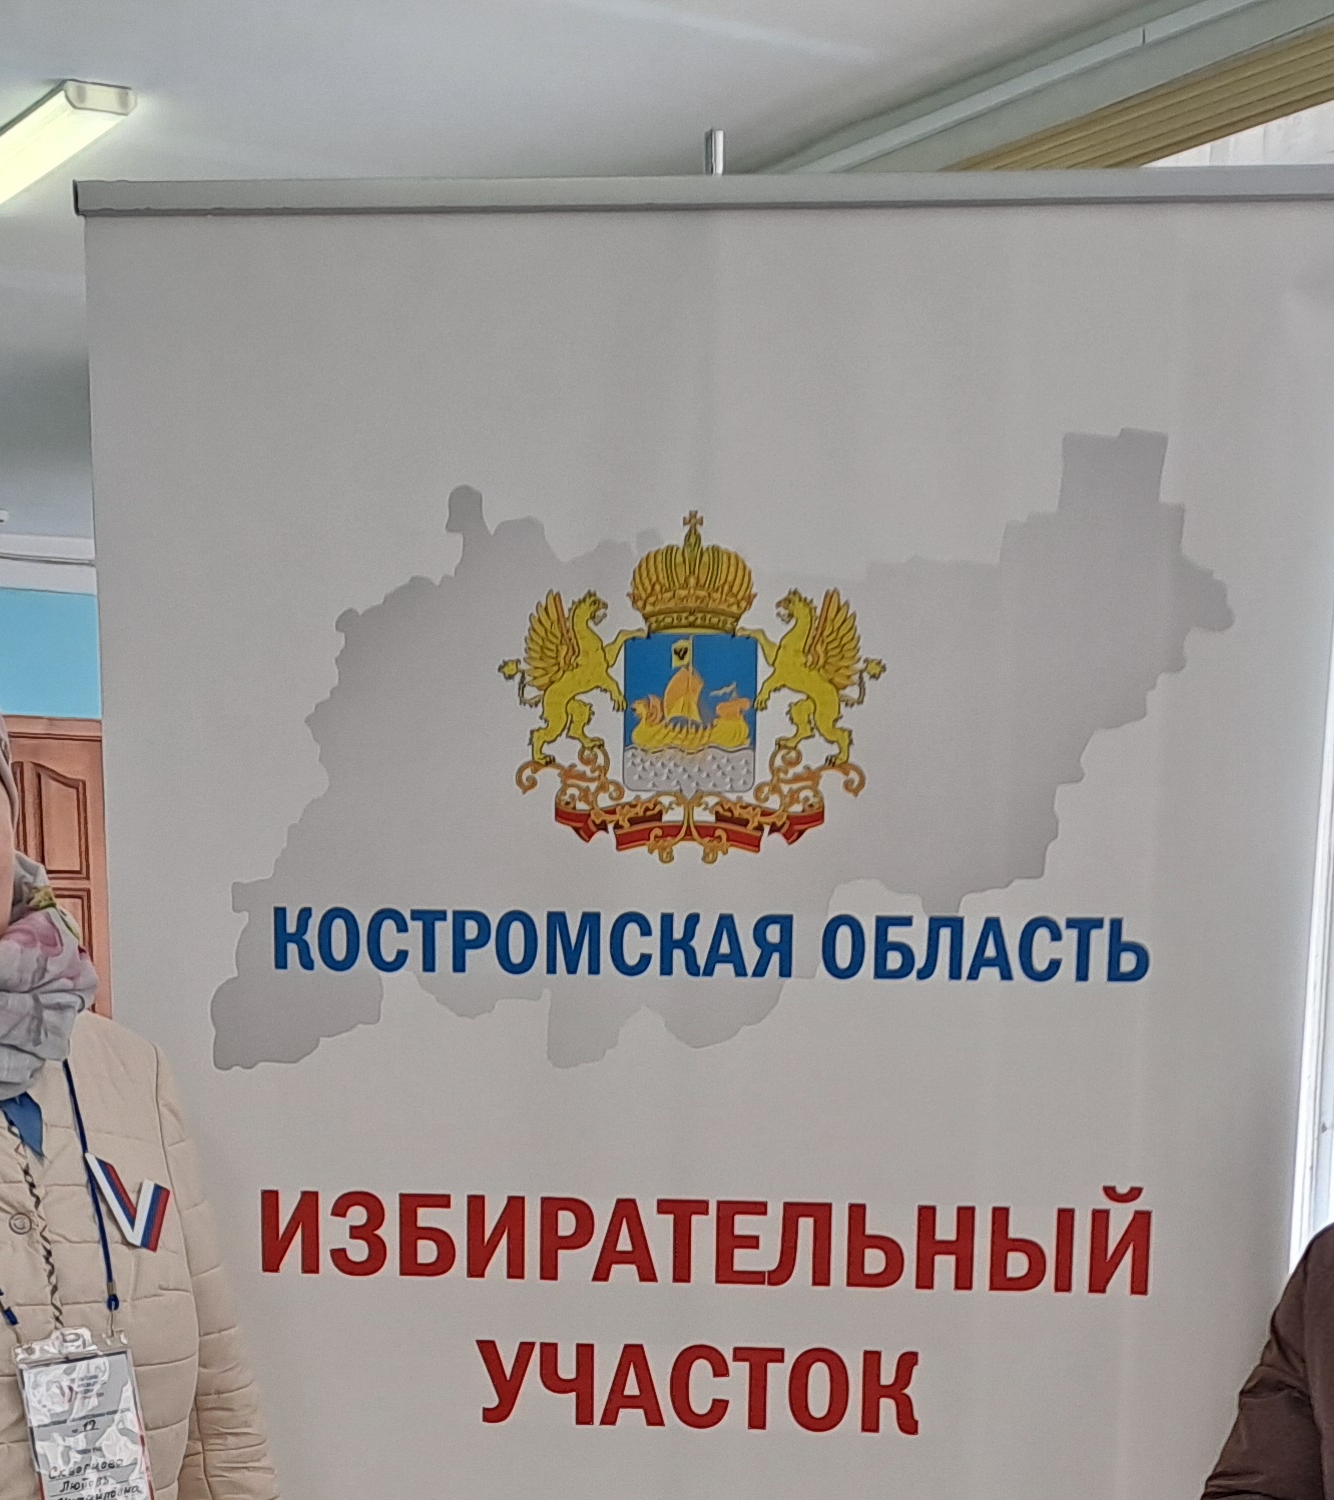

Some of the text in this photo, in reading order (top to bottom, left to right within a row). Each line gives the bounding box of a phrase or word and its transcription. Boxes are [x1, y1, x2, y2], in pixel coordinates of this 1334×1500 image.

[271, 906, 1151, 983] КОСТРОМСКАЯ ОБЛАСТЬ
[260, 1186, 1153, 1296] ИЗБИРАТЕЛЬНЫЙ
[474, 1339, 920, 1436] УЧАСТОК
